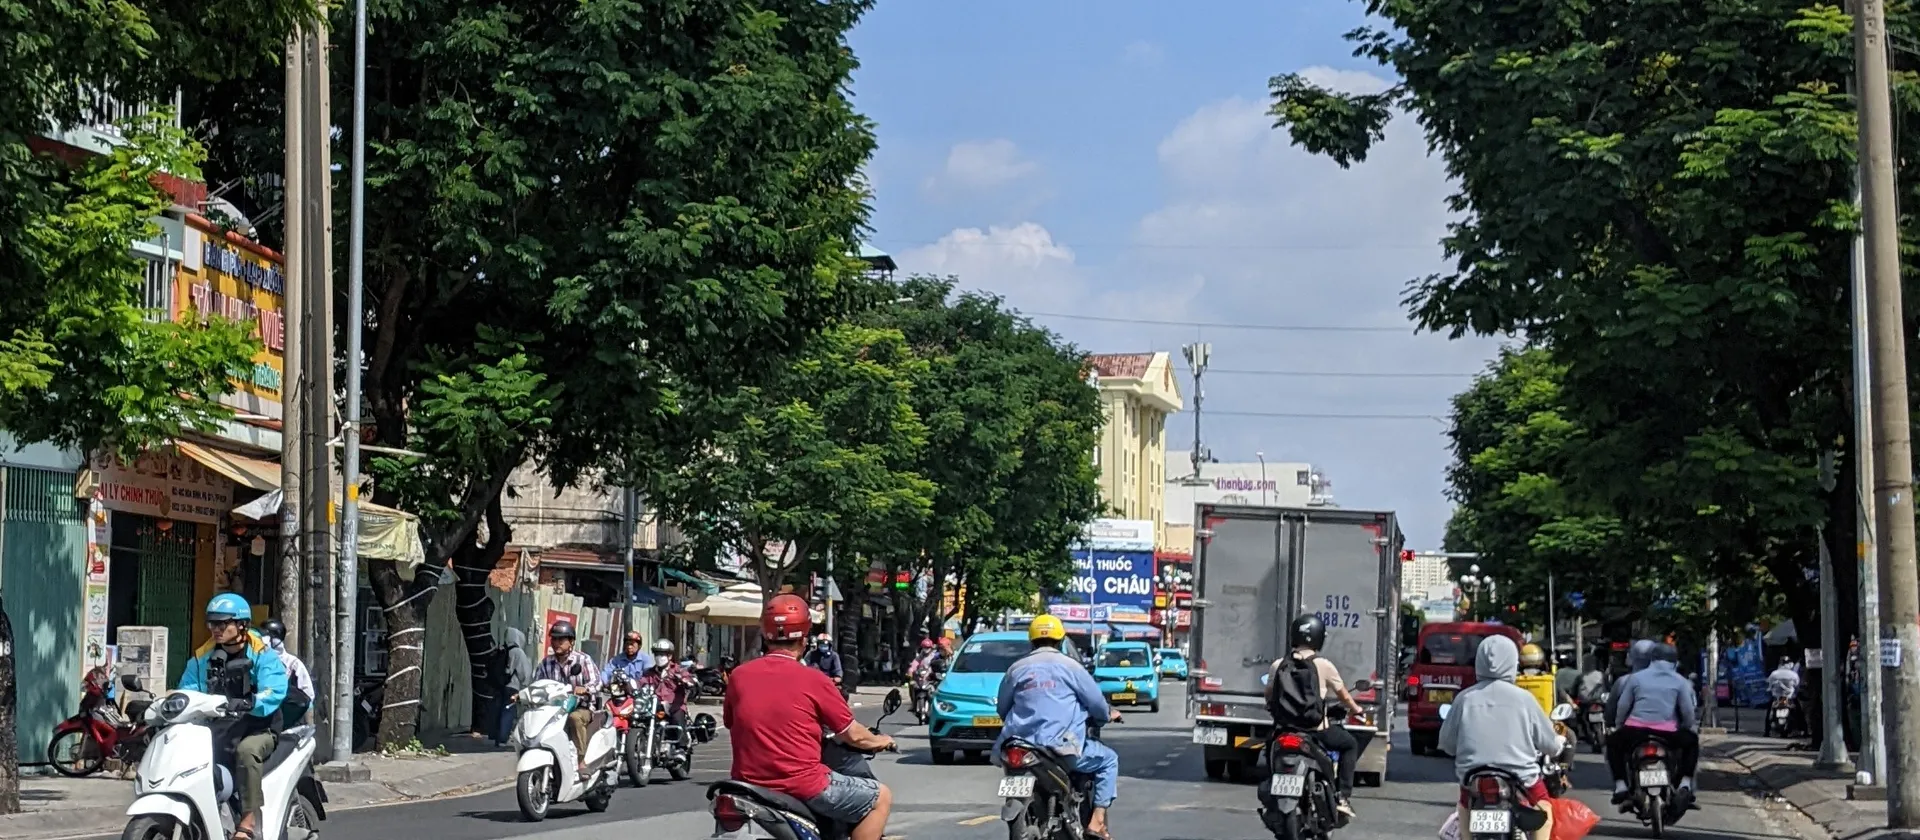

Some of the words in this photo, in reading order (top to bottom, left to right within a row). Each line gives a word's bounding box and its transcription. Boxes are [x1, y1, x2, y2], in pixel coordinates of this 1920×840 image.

[121, 481, 143, 502] CHÍNH
[1096, 556, 1133, 571] THUỐC
[1104, 574, 1150, 595] CHÂU
[1325, 594, 1350, 610] 51C
